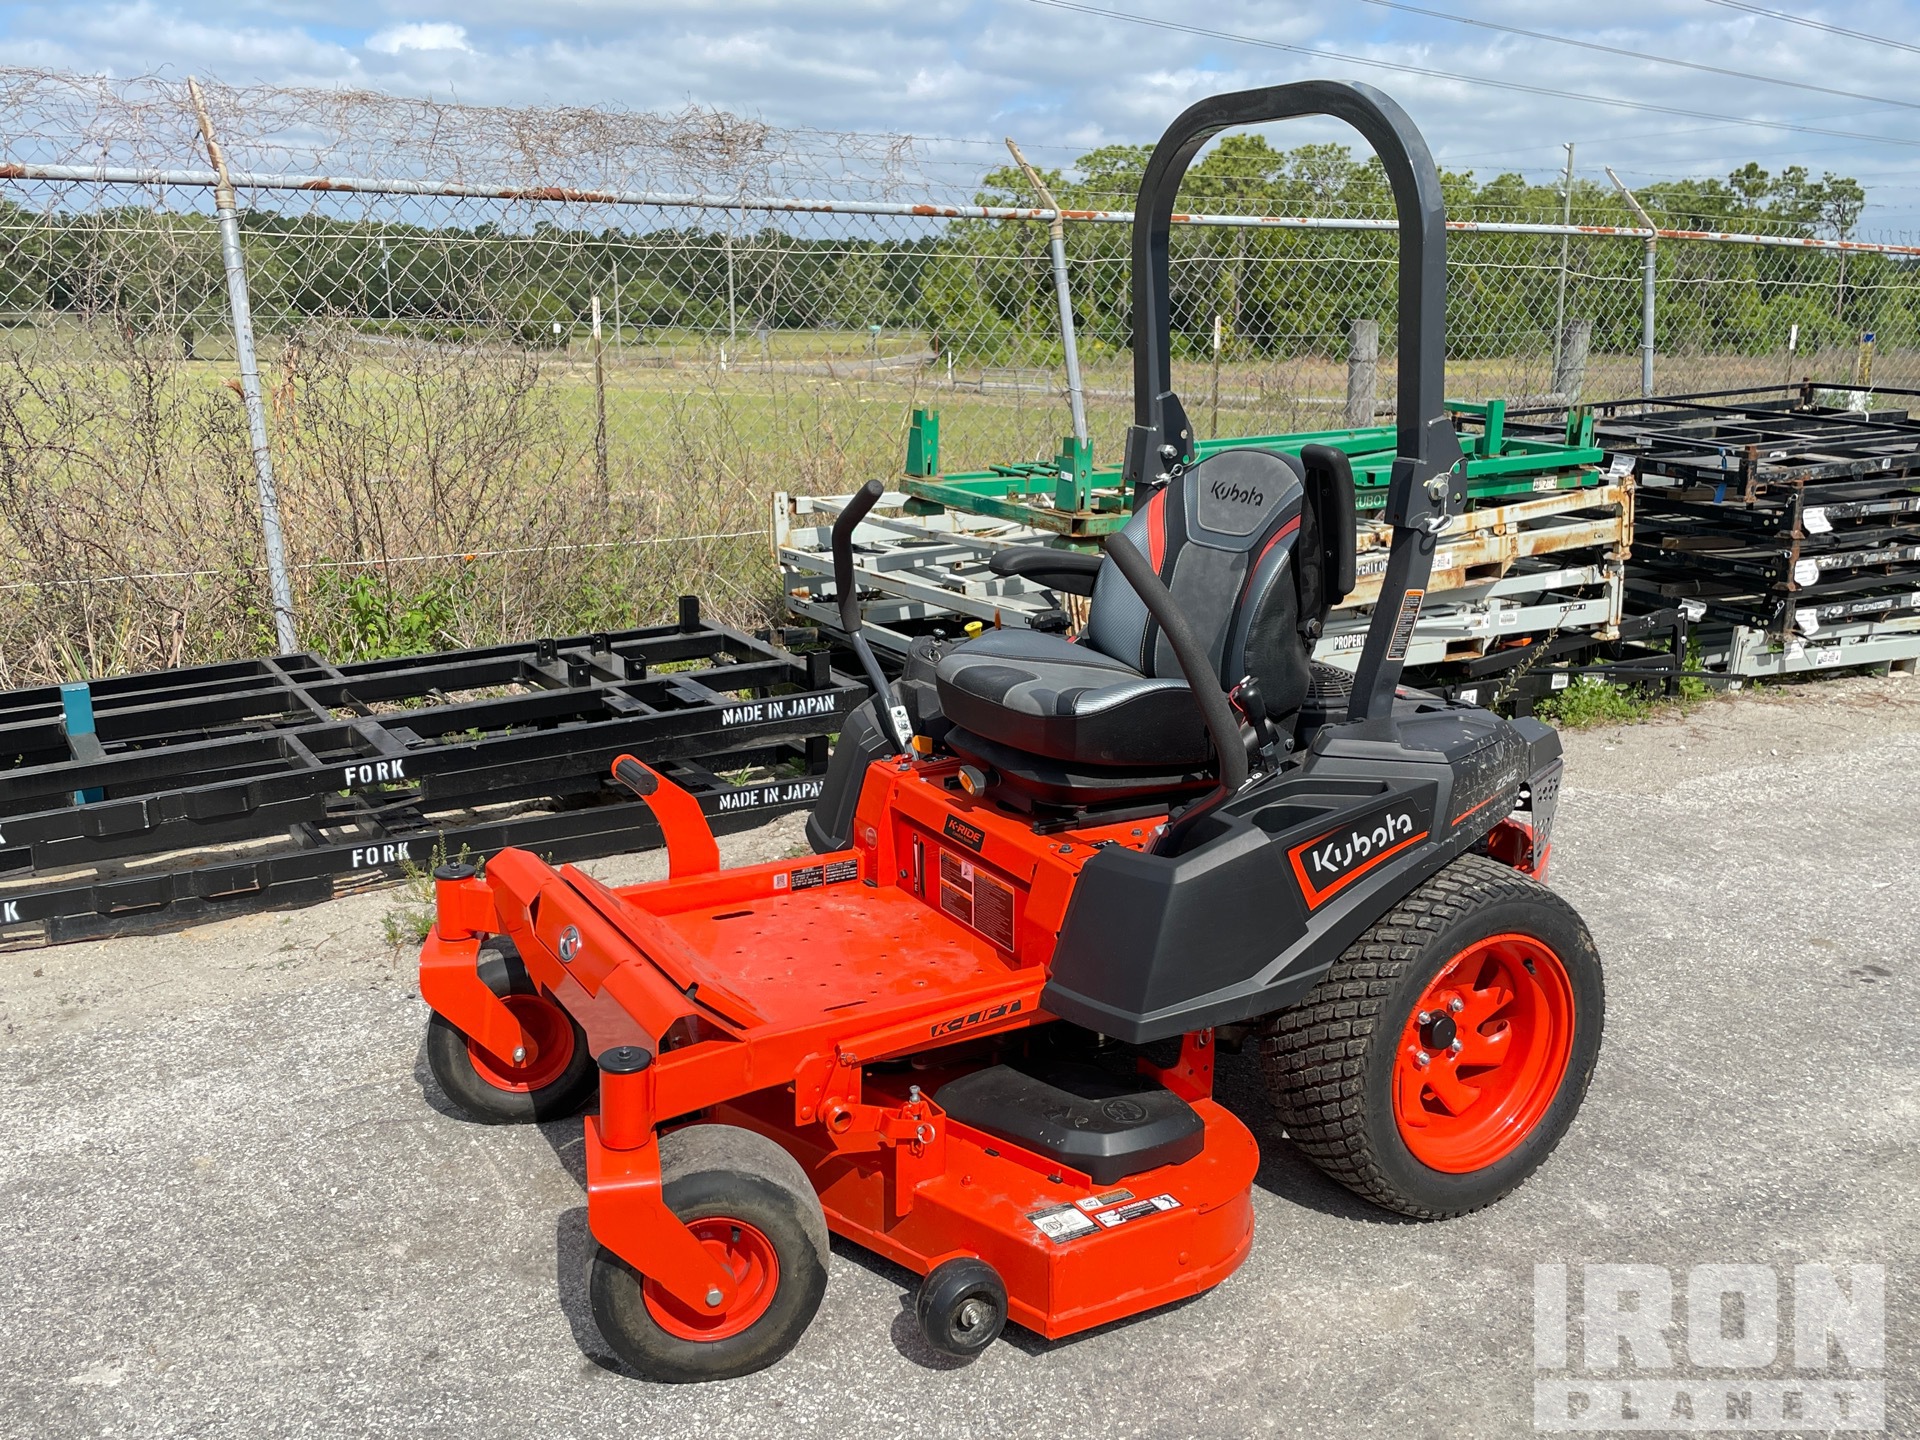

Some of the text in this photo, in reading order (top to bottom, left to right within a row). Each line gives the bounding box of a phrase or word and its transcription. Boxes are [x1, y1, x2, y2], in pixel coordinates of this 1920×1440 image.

[1210, 479, 1264, 507] Kubota
[1356, 562, 1378, 576] PERTY
[1334, 633, 1368, 649] PROPERT
[722, 694, 835, 725] MADE IN JAPAN
[344, 758, 405, 786] FORK
[719, 790, 759, 811] MADE
[764, 787, 779, 804] IN
[352, 841, 411, 868] FORK
[1312, 812, 1413, 873] Kubota
[933, 1000, 1019, 1037] K-LIFT
